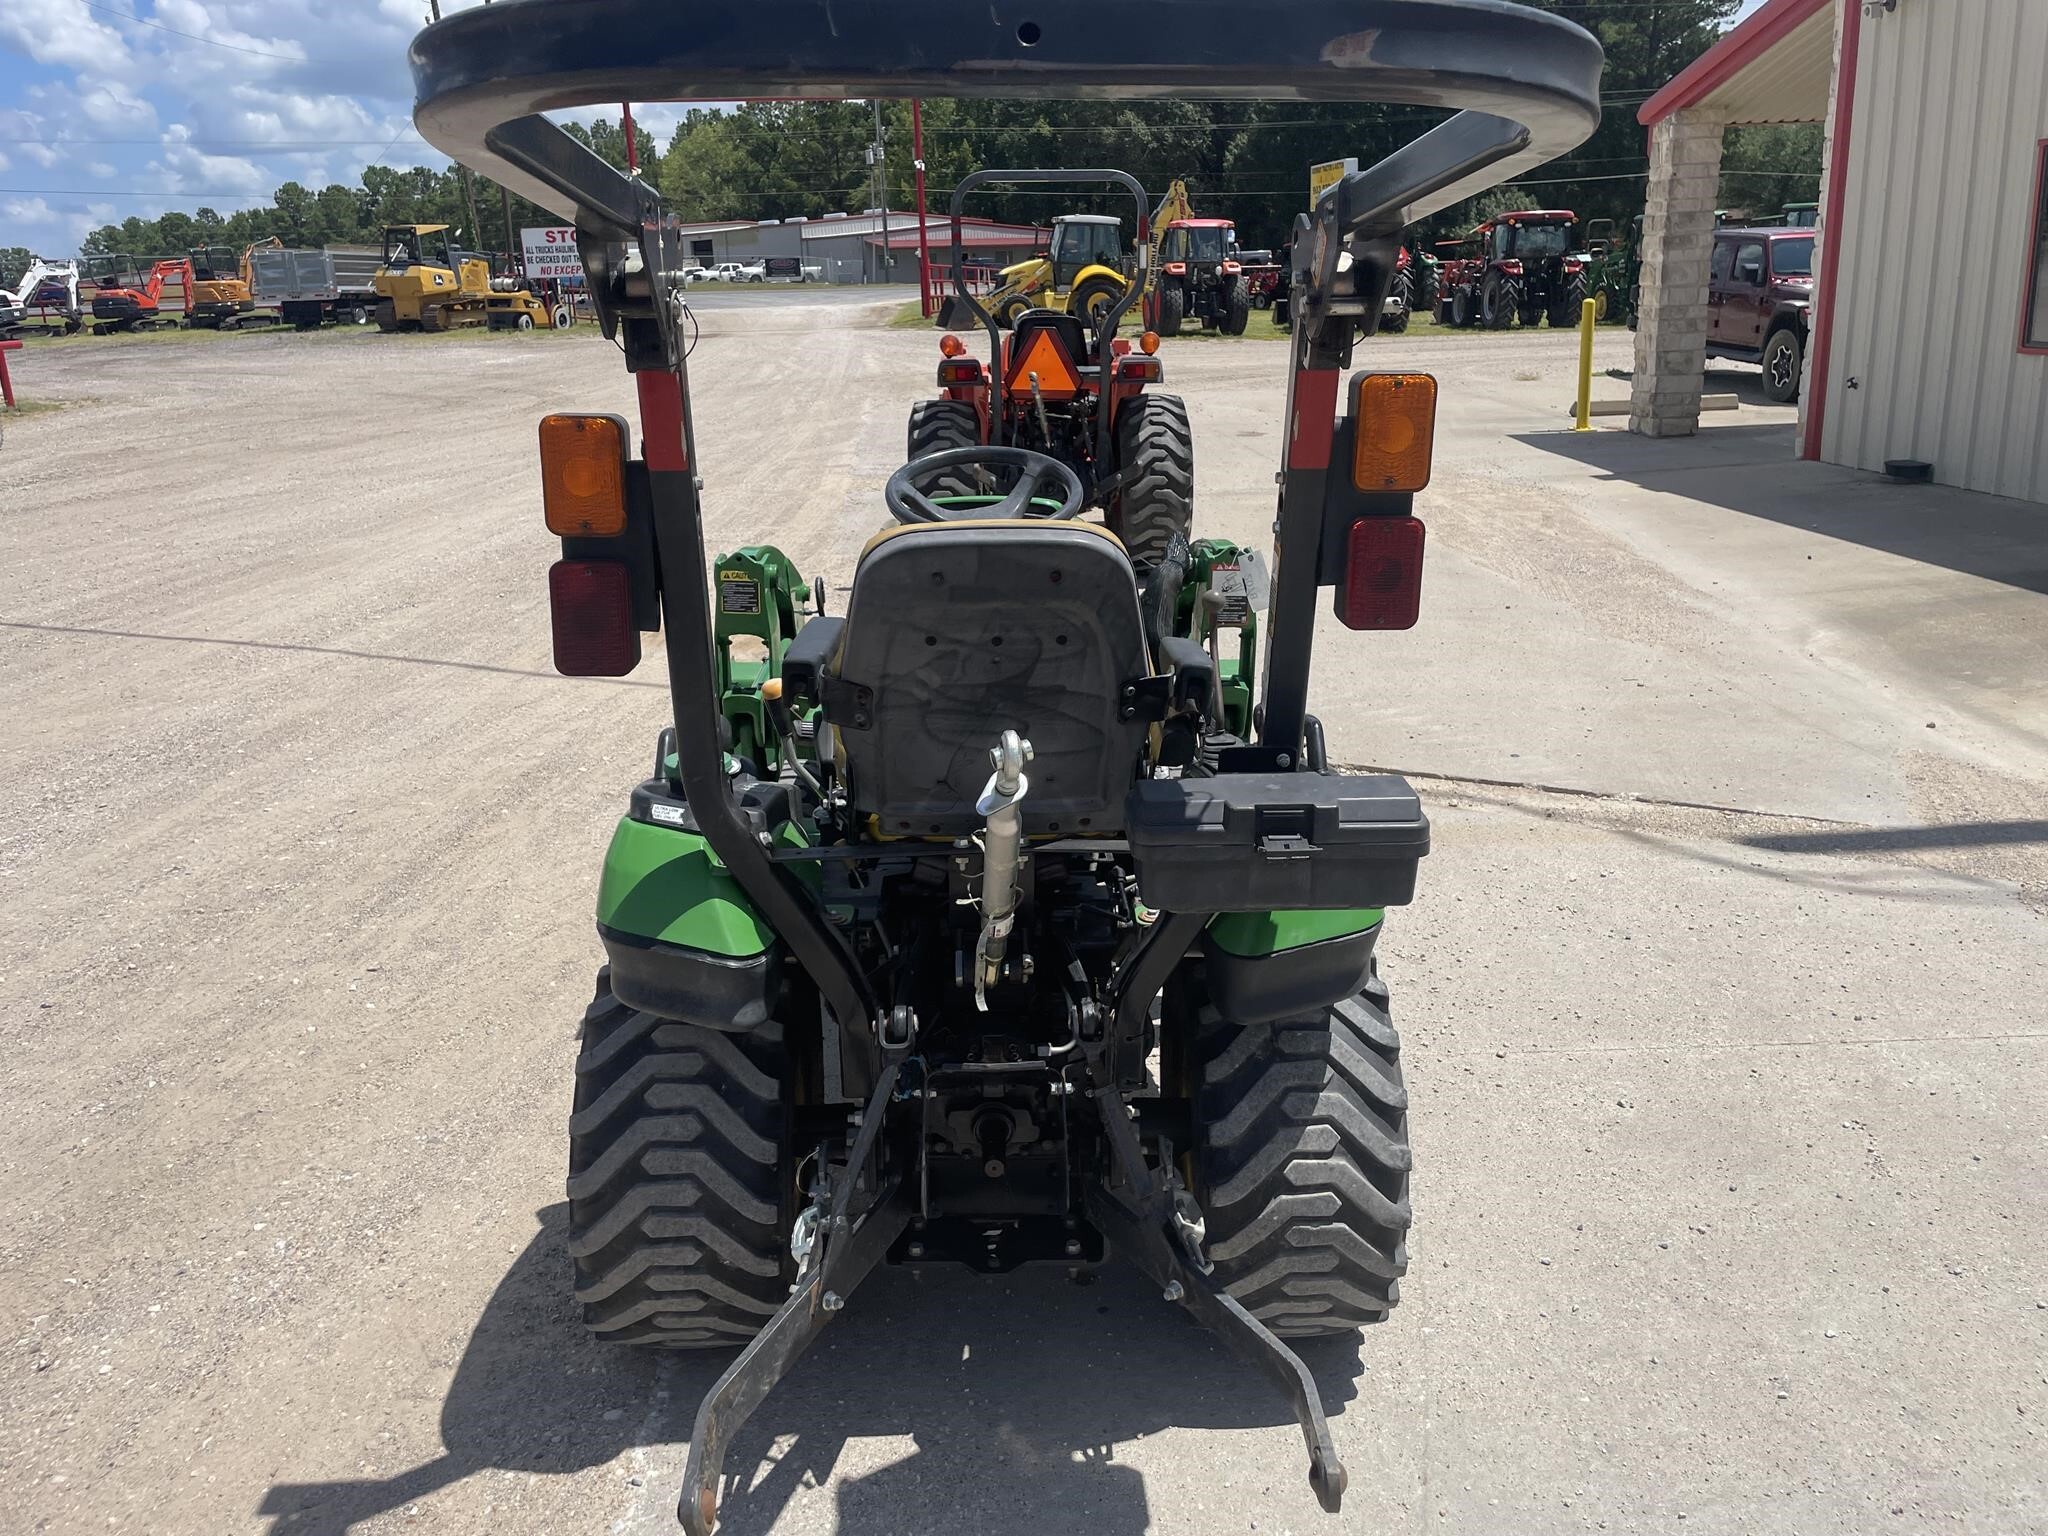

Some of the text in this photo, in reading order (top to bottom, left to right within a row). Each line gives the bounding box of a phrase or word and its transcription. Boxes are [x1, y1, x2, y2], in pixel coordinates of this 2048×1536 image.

[526, 245, 575, 254] ALL TRUCKS HAULING
[1150, 233, 1159, 268] HOLLAND
[526, 255, 534, 264] BE
[535, 255, 560, 264] CHECKED
[561, 254, 572, 263] OUT
[540, 265, 582, 275] NO EXCEP
